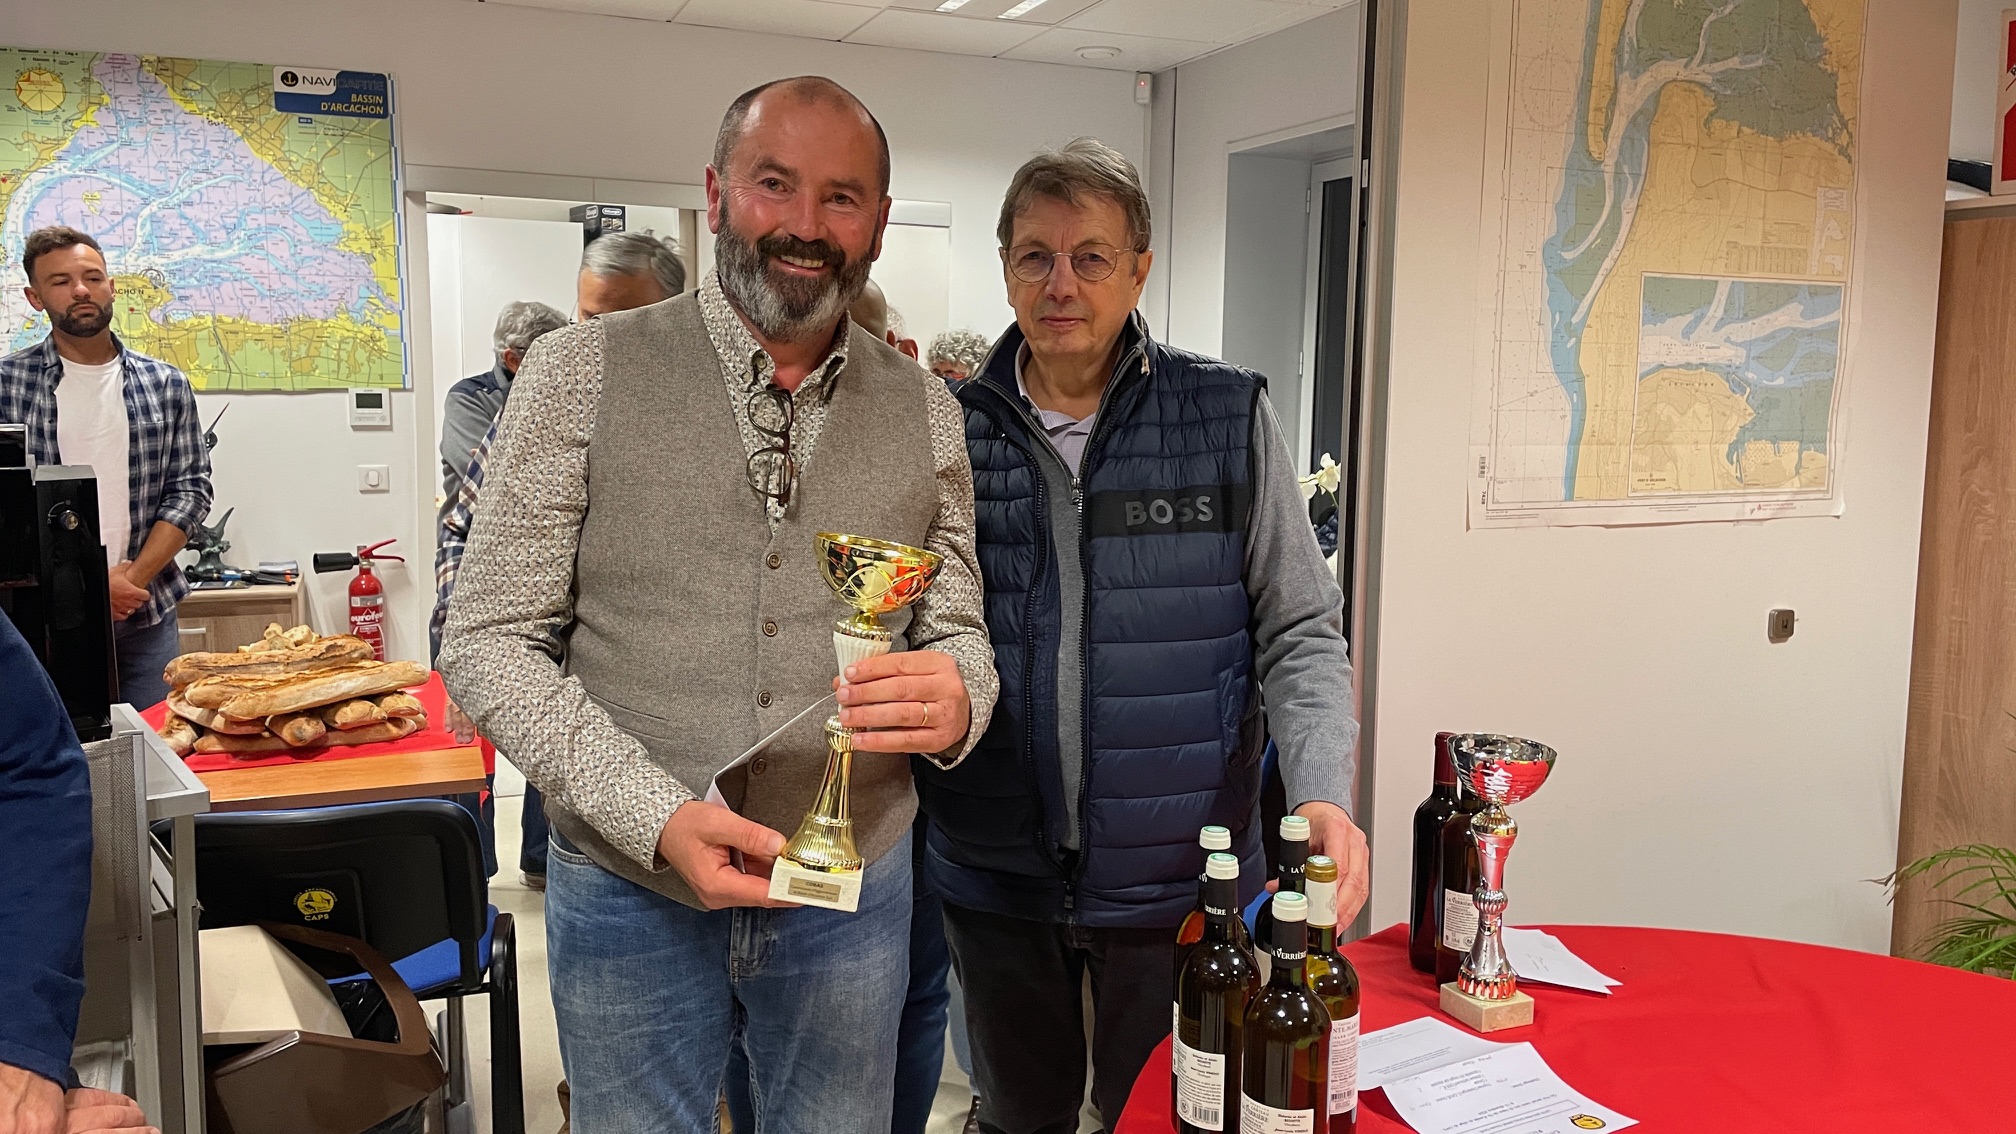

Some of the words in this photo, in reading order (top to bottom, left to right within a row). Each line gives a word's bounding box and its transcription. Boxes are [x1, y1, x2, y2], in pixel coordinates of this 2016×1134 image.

[351, 94, 383, 104] BASSIN
[321, 102, 384, 115] D'ARCACHON
[1125, 495, 1213, 526] BOSS
[304, 913, 330, 921] CAPS
